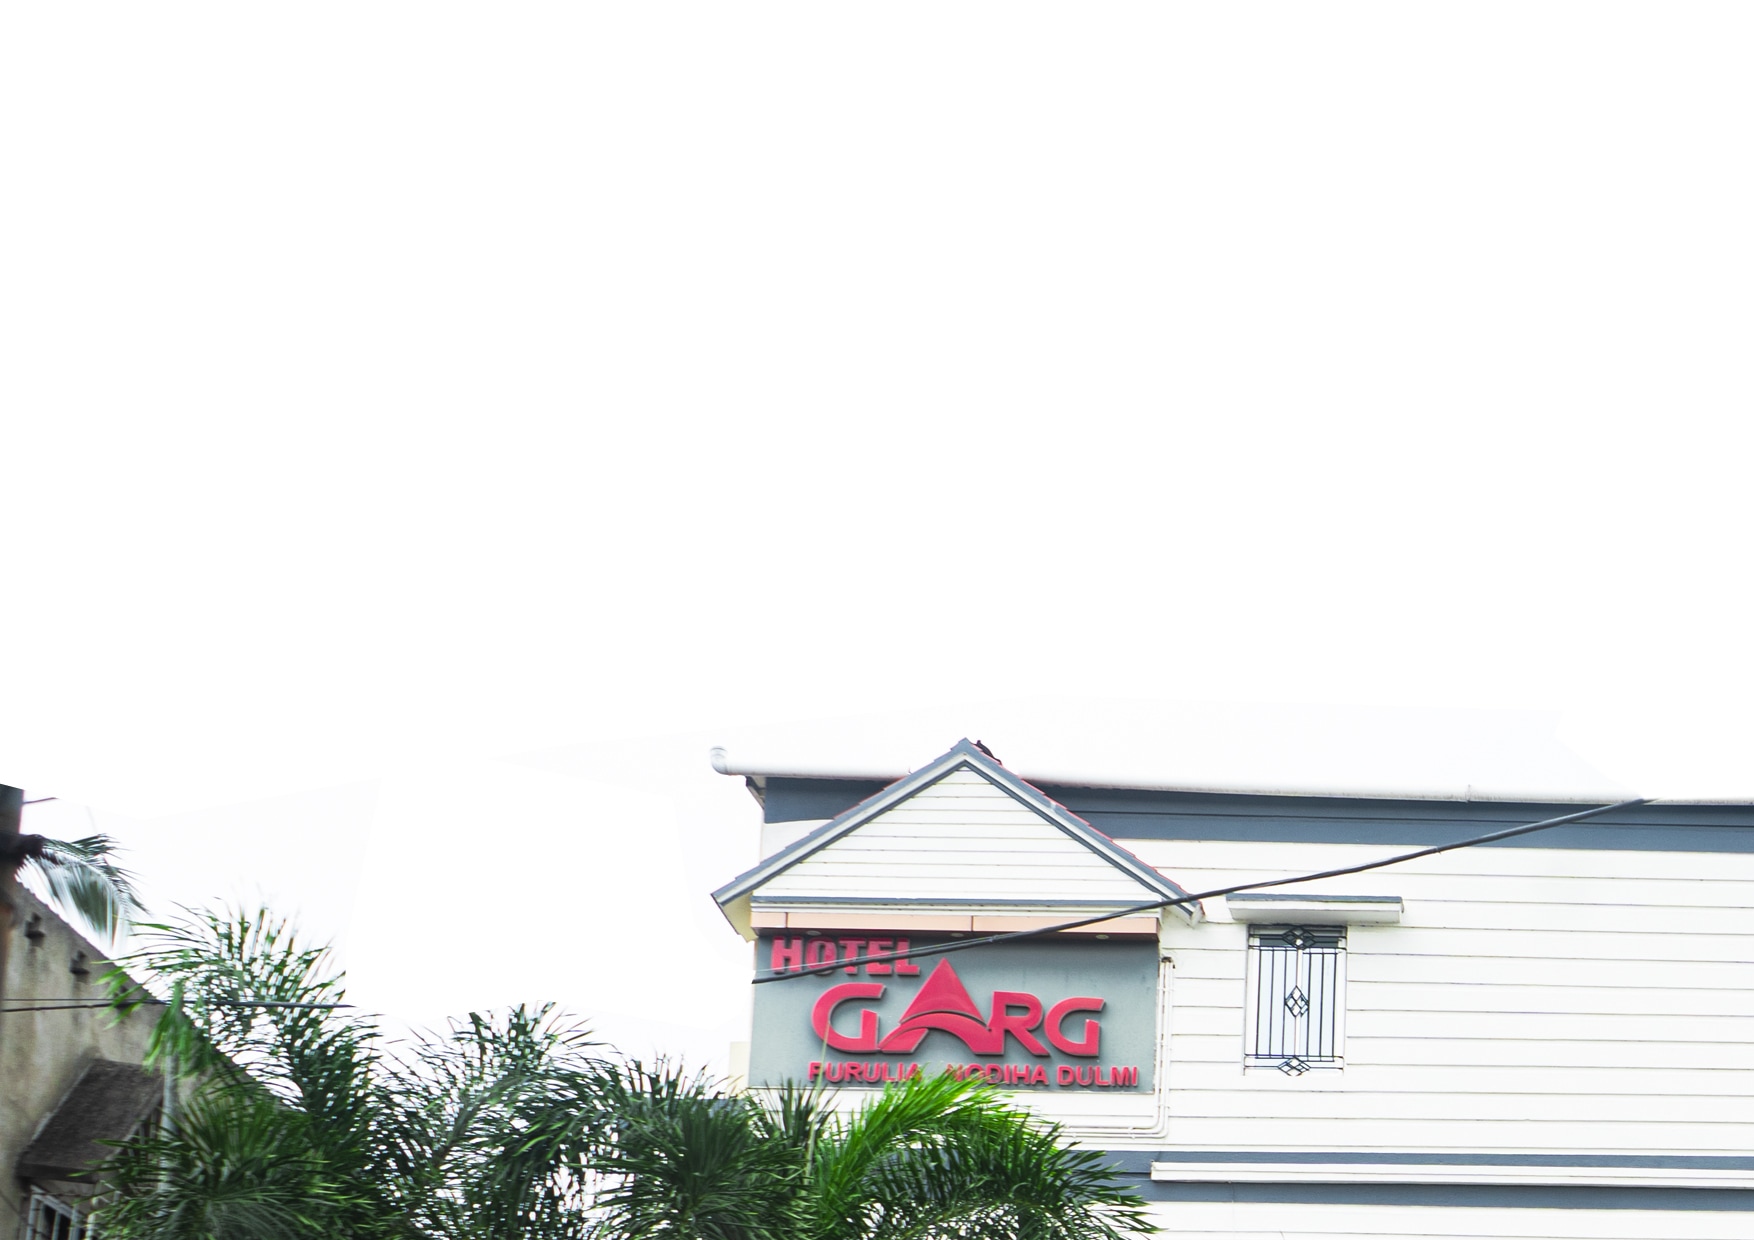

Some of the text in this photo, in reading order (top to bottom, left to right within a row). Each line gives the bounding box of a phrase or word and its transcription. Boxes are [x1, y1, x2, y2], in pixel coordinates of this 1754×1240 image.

[770, 936, 920, 976] HOTEL
[811, 957, 1105, 1056] GARG
[808, 1061, 922, 1083] PURULIA
[1056, 1065, 1139, 1086] DULMI
